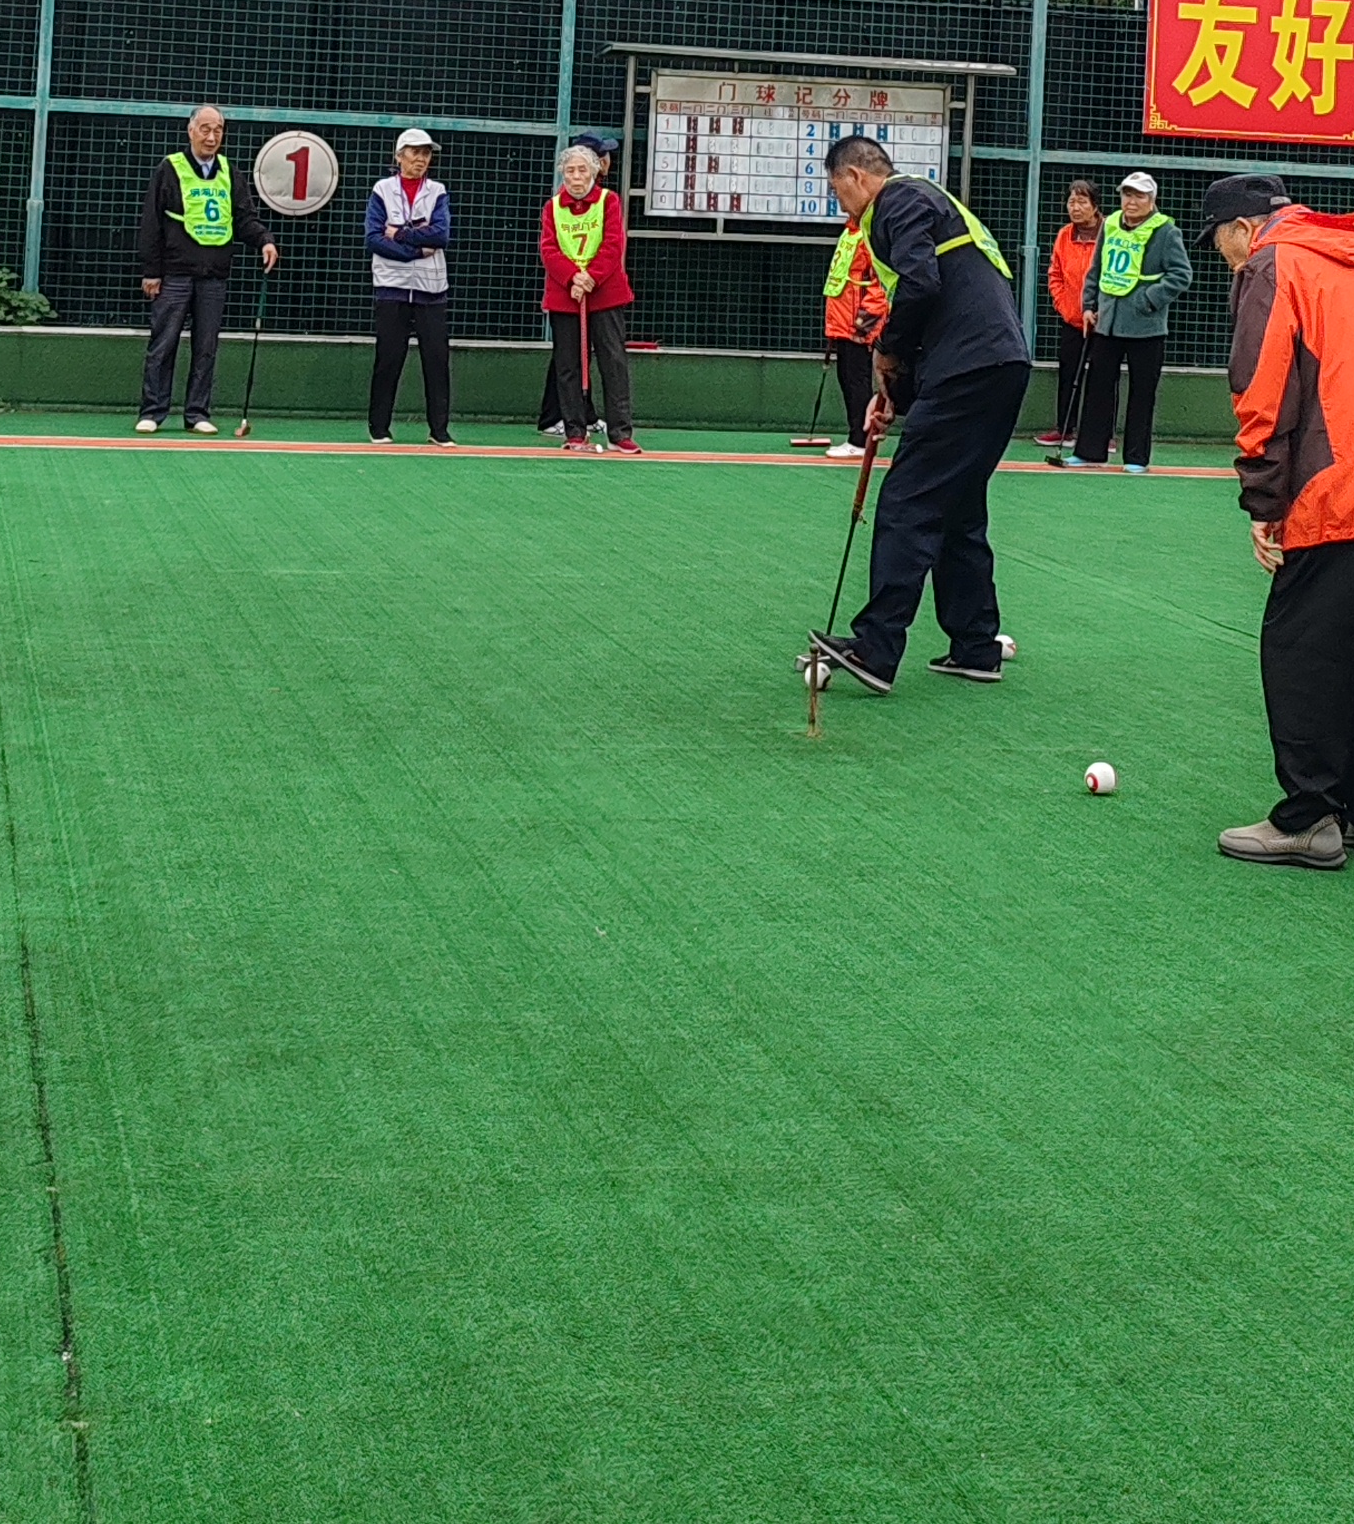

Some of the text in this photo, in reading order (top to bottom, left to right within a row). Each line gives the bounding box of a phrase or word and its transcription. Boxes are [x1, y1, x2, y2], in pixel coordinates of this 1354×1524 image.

[718, 81, 889, 110] 门球记分牌
[659, 102, 679, 113] 号码
[664, 117, 670, 130] 1
[806, 123, 816, 137] 2
[805, 143, 815, 156] 4
[661, 157, 669, 170] 5
[805, 162, 814, 175] 6
[285, 145, 310, 201] 1
[804, 180, 813, 194] 8
[205, 198, 220, 222] 6
[800, 199, 817, 214] 10
[572, 233, 587, 256] 7
[1107, 248, 1131, 274] 10
